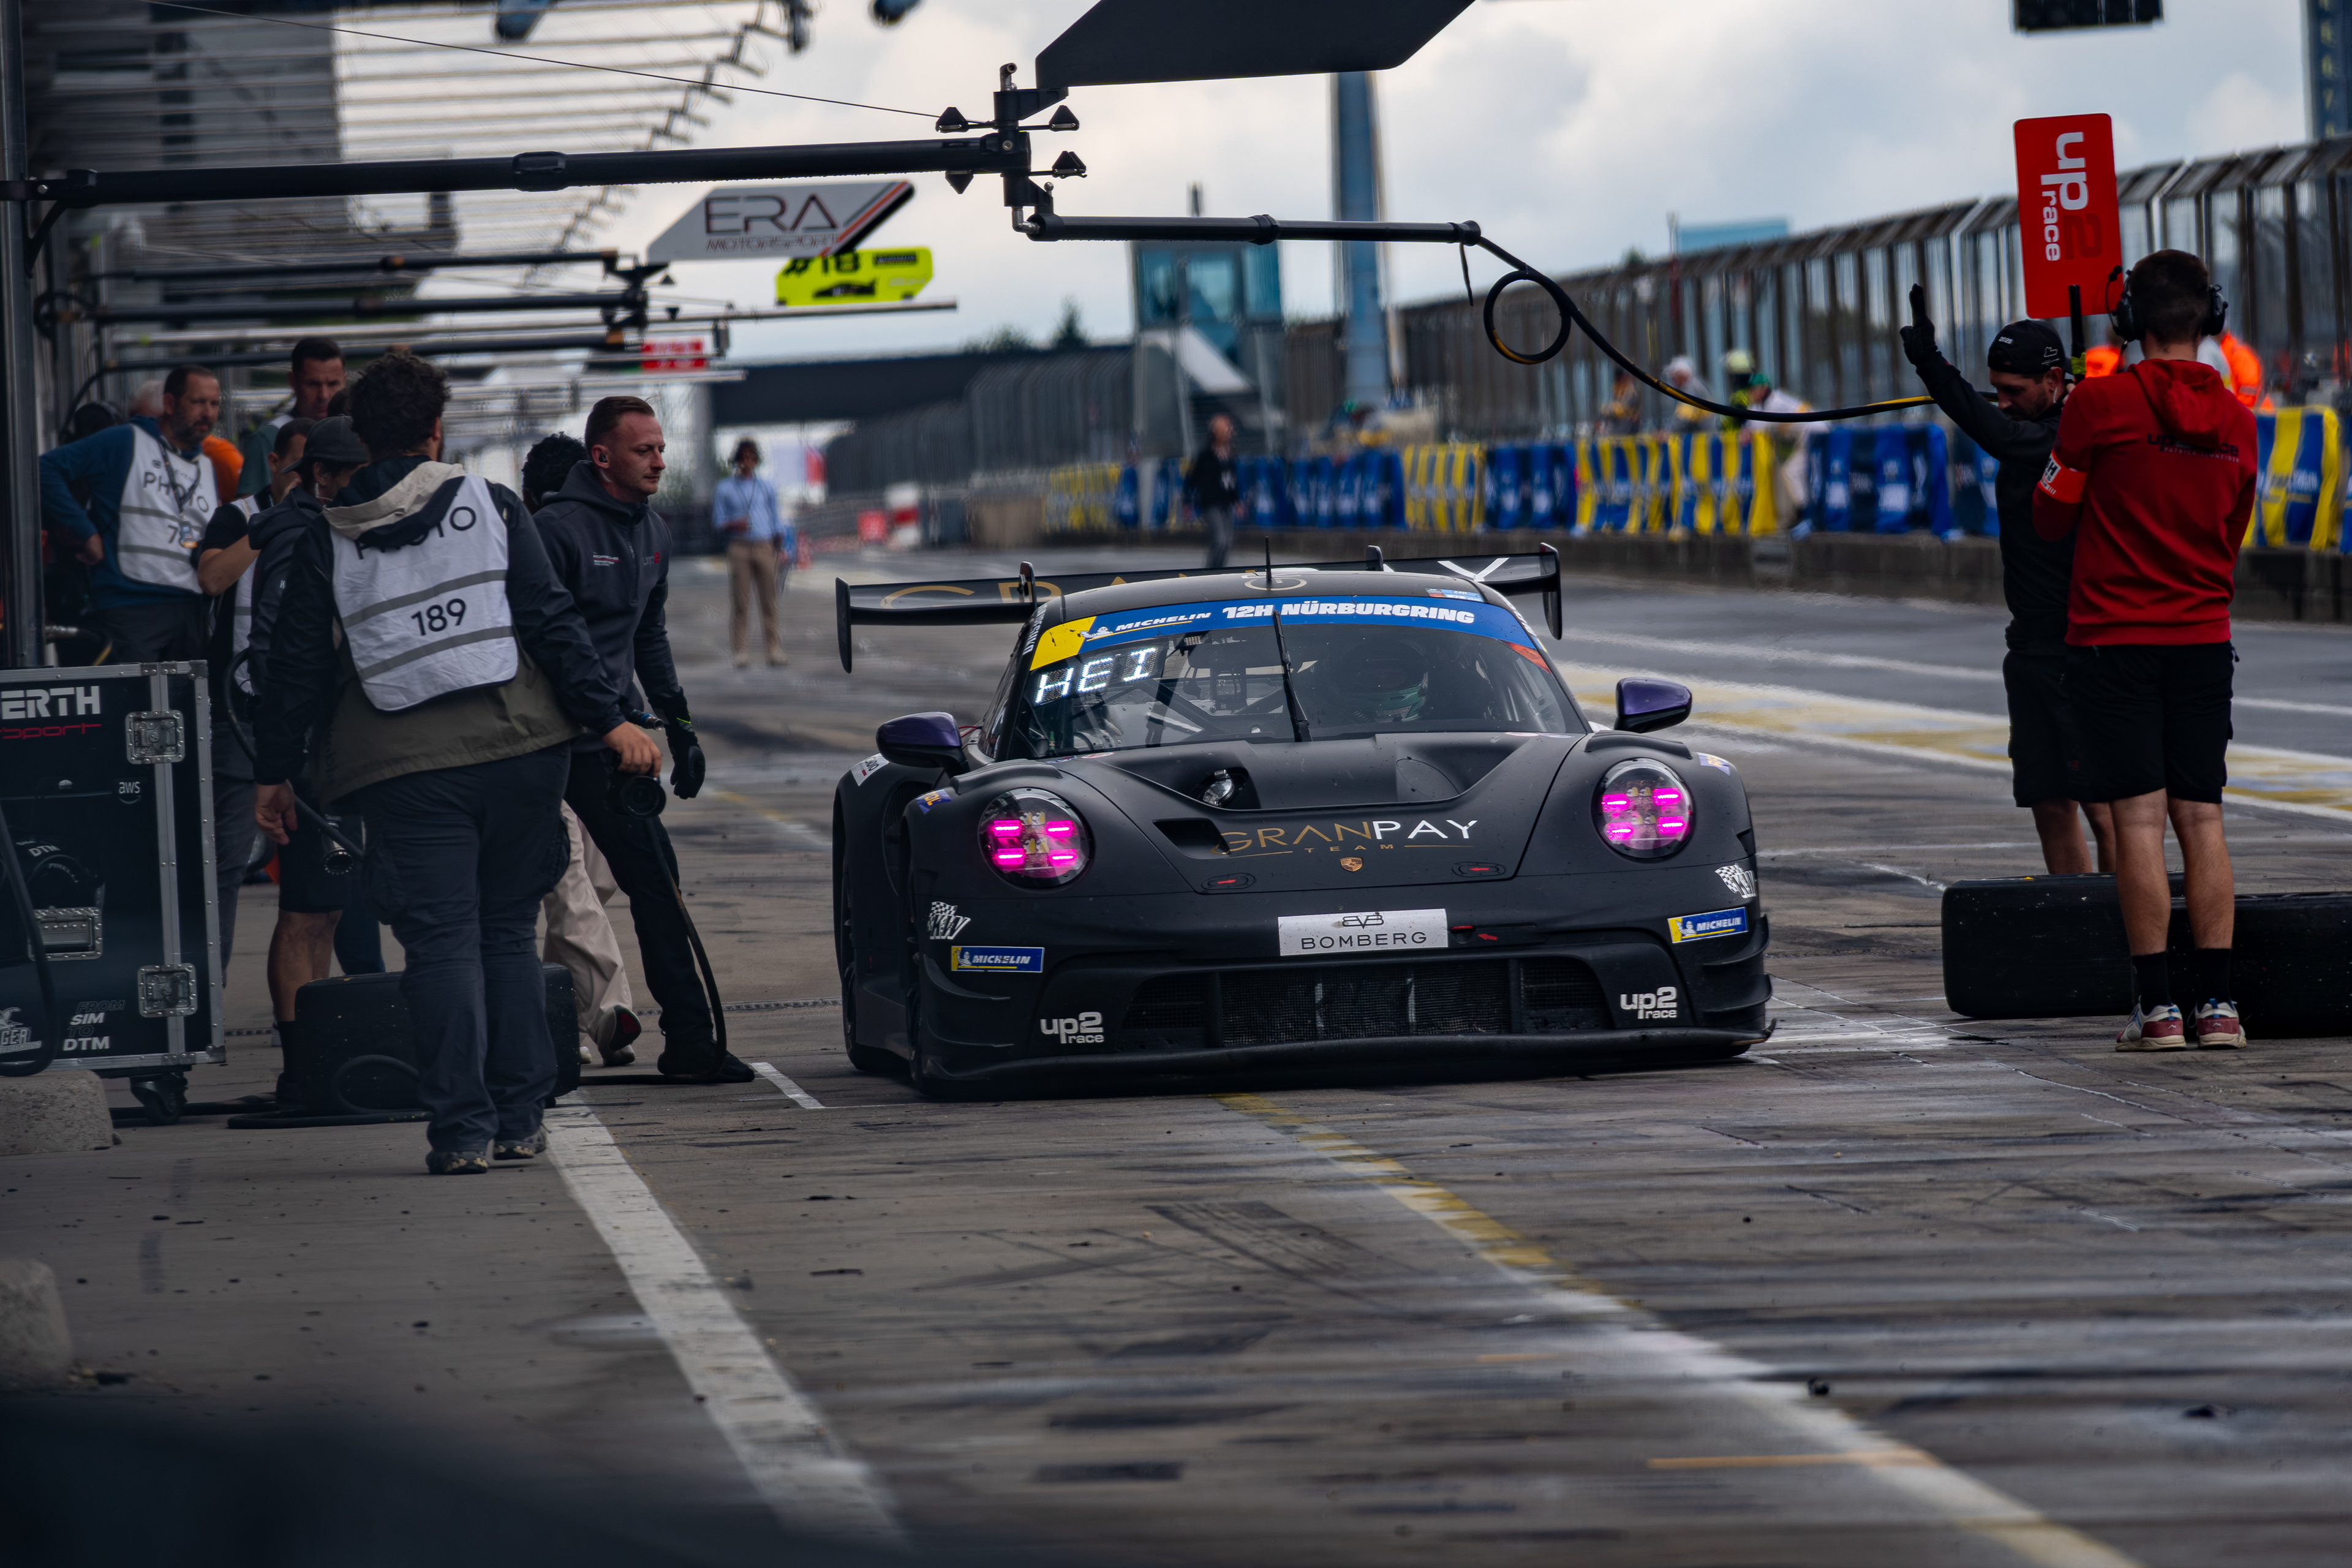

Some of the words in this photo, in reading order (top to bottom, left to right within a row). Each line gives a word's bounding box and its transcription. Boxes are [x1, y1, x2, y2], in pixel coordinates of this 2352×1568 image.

[705, 194, 839, 235] ERA
[2041, 190, 2061, 261] race
[706, 235, 841, 253] MOTORSPORT
[411, 598, 466, 636] 189
[1115, 612, 1212, 631] MICHELIN
[1222, 604, 1275, 619] 12H
[1280, 600, 1475, 624] NÜRBURGRING
[1036, 647, 1158, 704] HEI
[119, 782, 140, 794] aws
[1210, 820, 1478, 855] GRANPAY
[28, 845, 61, 857] DTM
[1304, 844, 1393, 853] TEAM
[1696, 917, 1742, 932] MICHELIN
[1301, 932, 1427, 949] BOMBERG
[972, 955, 1031, 964] MICHELIN
[76, 1000, 126, 1014] FROM
[1620, 986, 1677, 1019] up2
[70, 1012, 105, 1025] SIM
[1645, 1009, 1678, 1019] race
[67, 1025, 94, 1038] TO
[1040, 1011, 1104, 1044] up2
[62, 1036, 111, 1051] DTM
[1068, 1035, 1104, 1044] race
